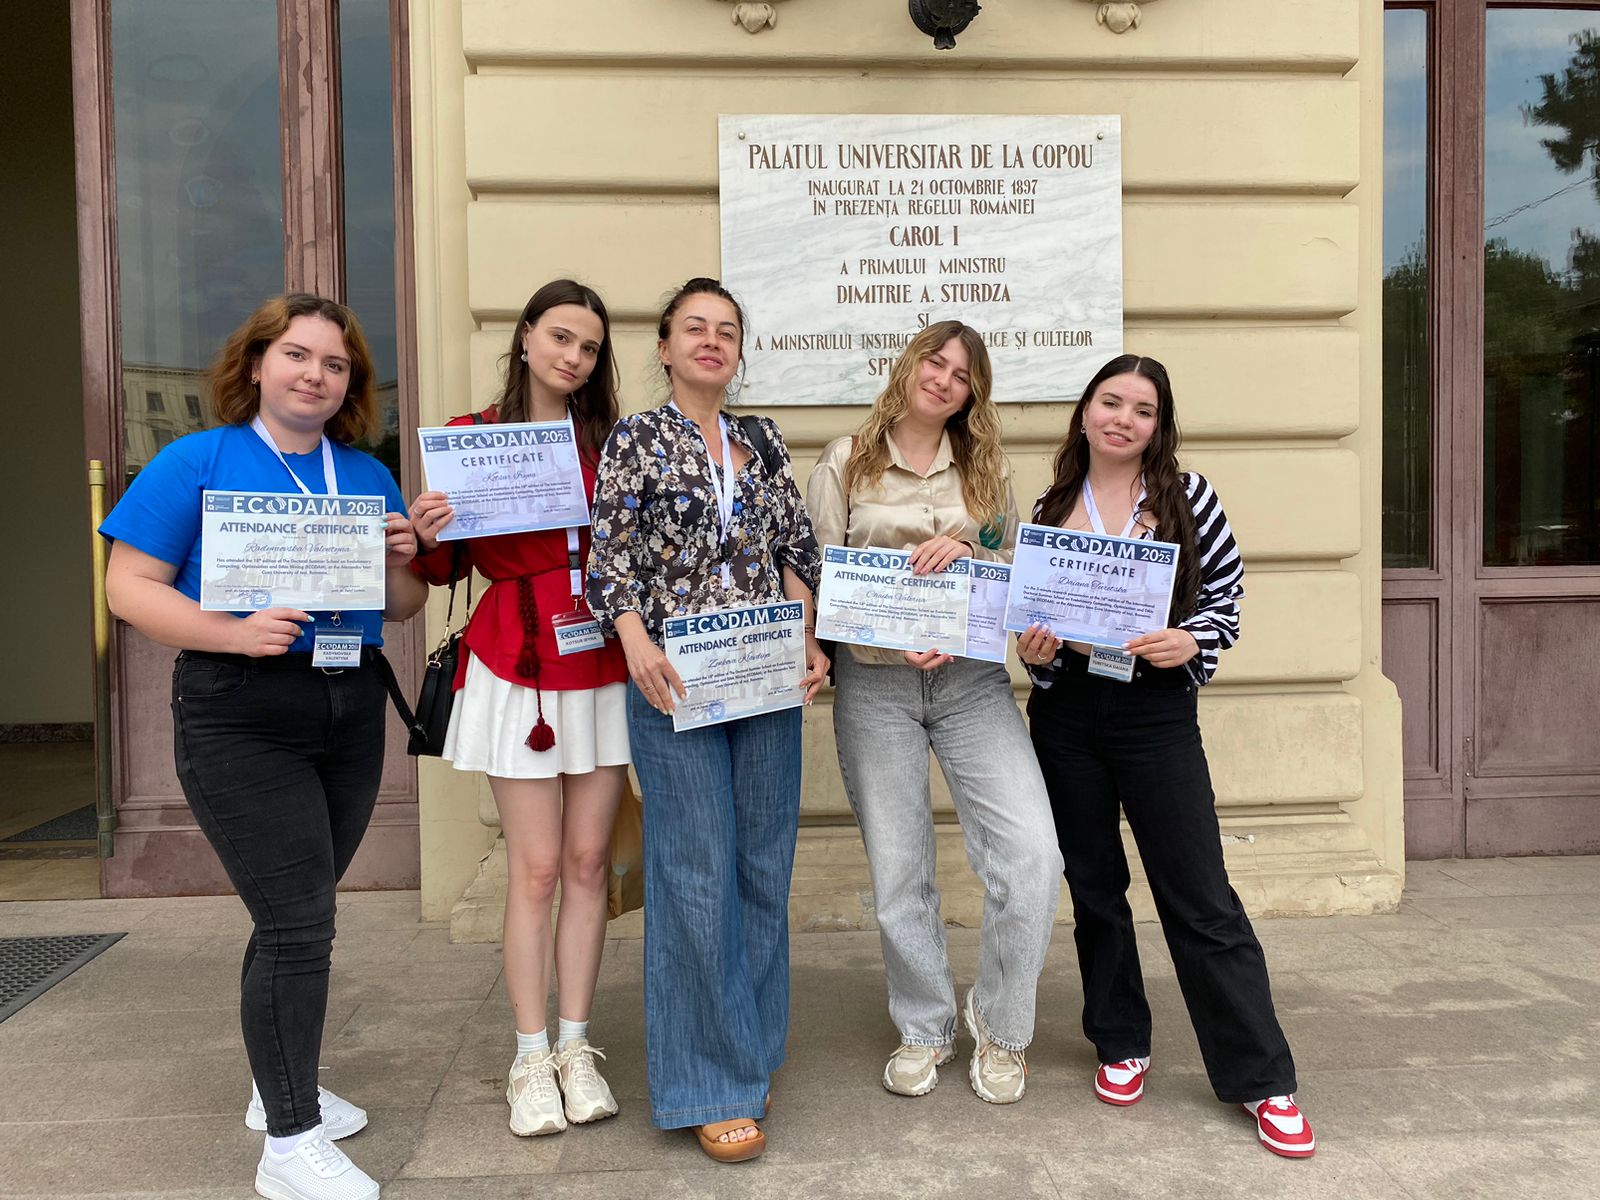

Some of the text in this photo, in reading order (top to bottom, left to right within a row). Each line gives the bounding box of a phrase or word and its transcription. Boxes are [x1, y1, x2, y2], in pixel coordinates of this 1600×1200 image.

[749, 143, 1093, 169] PALATUL UNIVERSITAR DE LA COPOU
[808, 179, 1038, 196] INAUGURAT LA 21 OCTOMBRIE 1897
[813, 197, 826, 215] ÎN
[908, 199, 961, 215] REGELUI
[890, 225, 959, 247] CAROL I
[840, 258, 1006, 275] A PRIMULUI MINISTRU
[837, 284, 1011, 304] DIMITRIE A. STURDZA
[755, 331, 1093, 350] A MINISTRULUI INSTRUC LICE ȘI CULTELOR
[868, 357, 894, 376] SPI
[447, 430, 538, 450] ECODAM
[541, 430, 569, 443] 2025
[461, 452, 544, 468] CERTIFICATE
[233, 496, 341, 515] ECODAM
[347, 501, 380, 516] 2025
[220, 522, 369, 535] ATTENDANCE CERTIFICATE
[1043, 532, 1136, 559] ECODAM
[1140, 547, 1171, 564] 2025
[846, 551, 913, 571] ECODA
[942, 561, 966, 573] 025
[1050, 557, 1136, 578] CERTIFICATE
[834, 570, 896, 584] ATTENDANCE
[901, 578, 956, 590] CERTIFICATE
[980, 567, 1008, 580] 2025
[686, 609, 770, 635] ECODAM
[774, 607, 800, 621] 2025
[678, 629, 792, 656] ATTENDANCE CERTIFICATE
